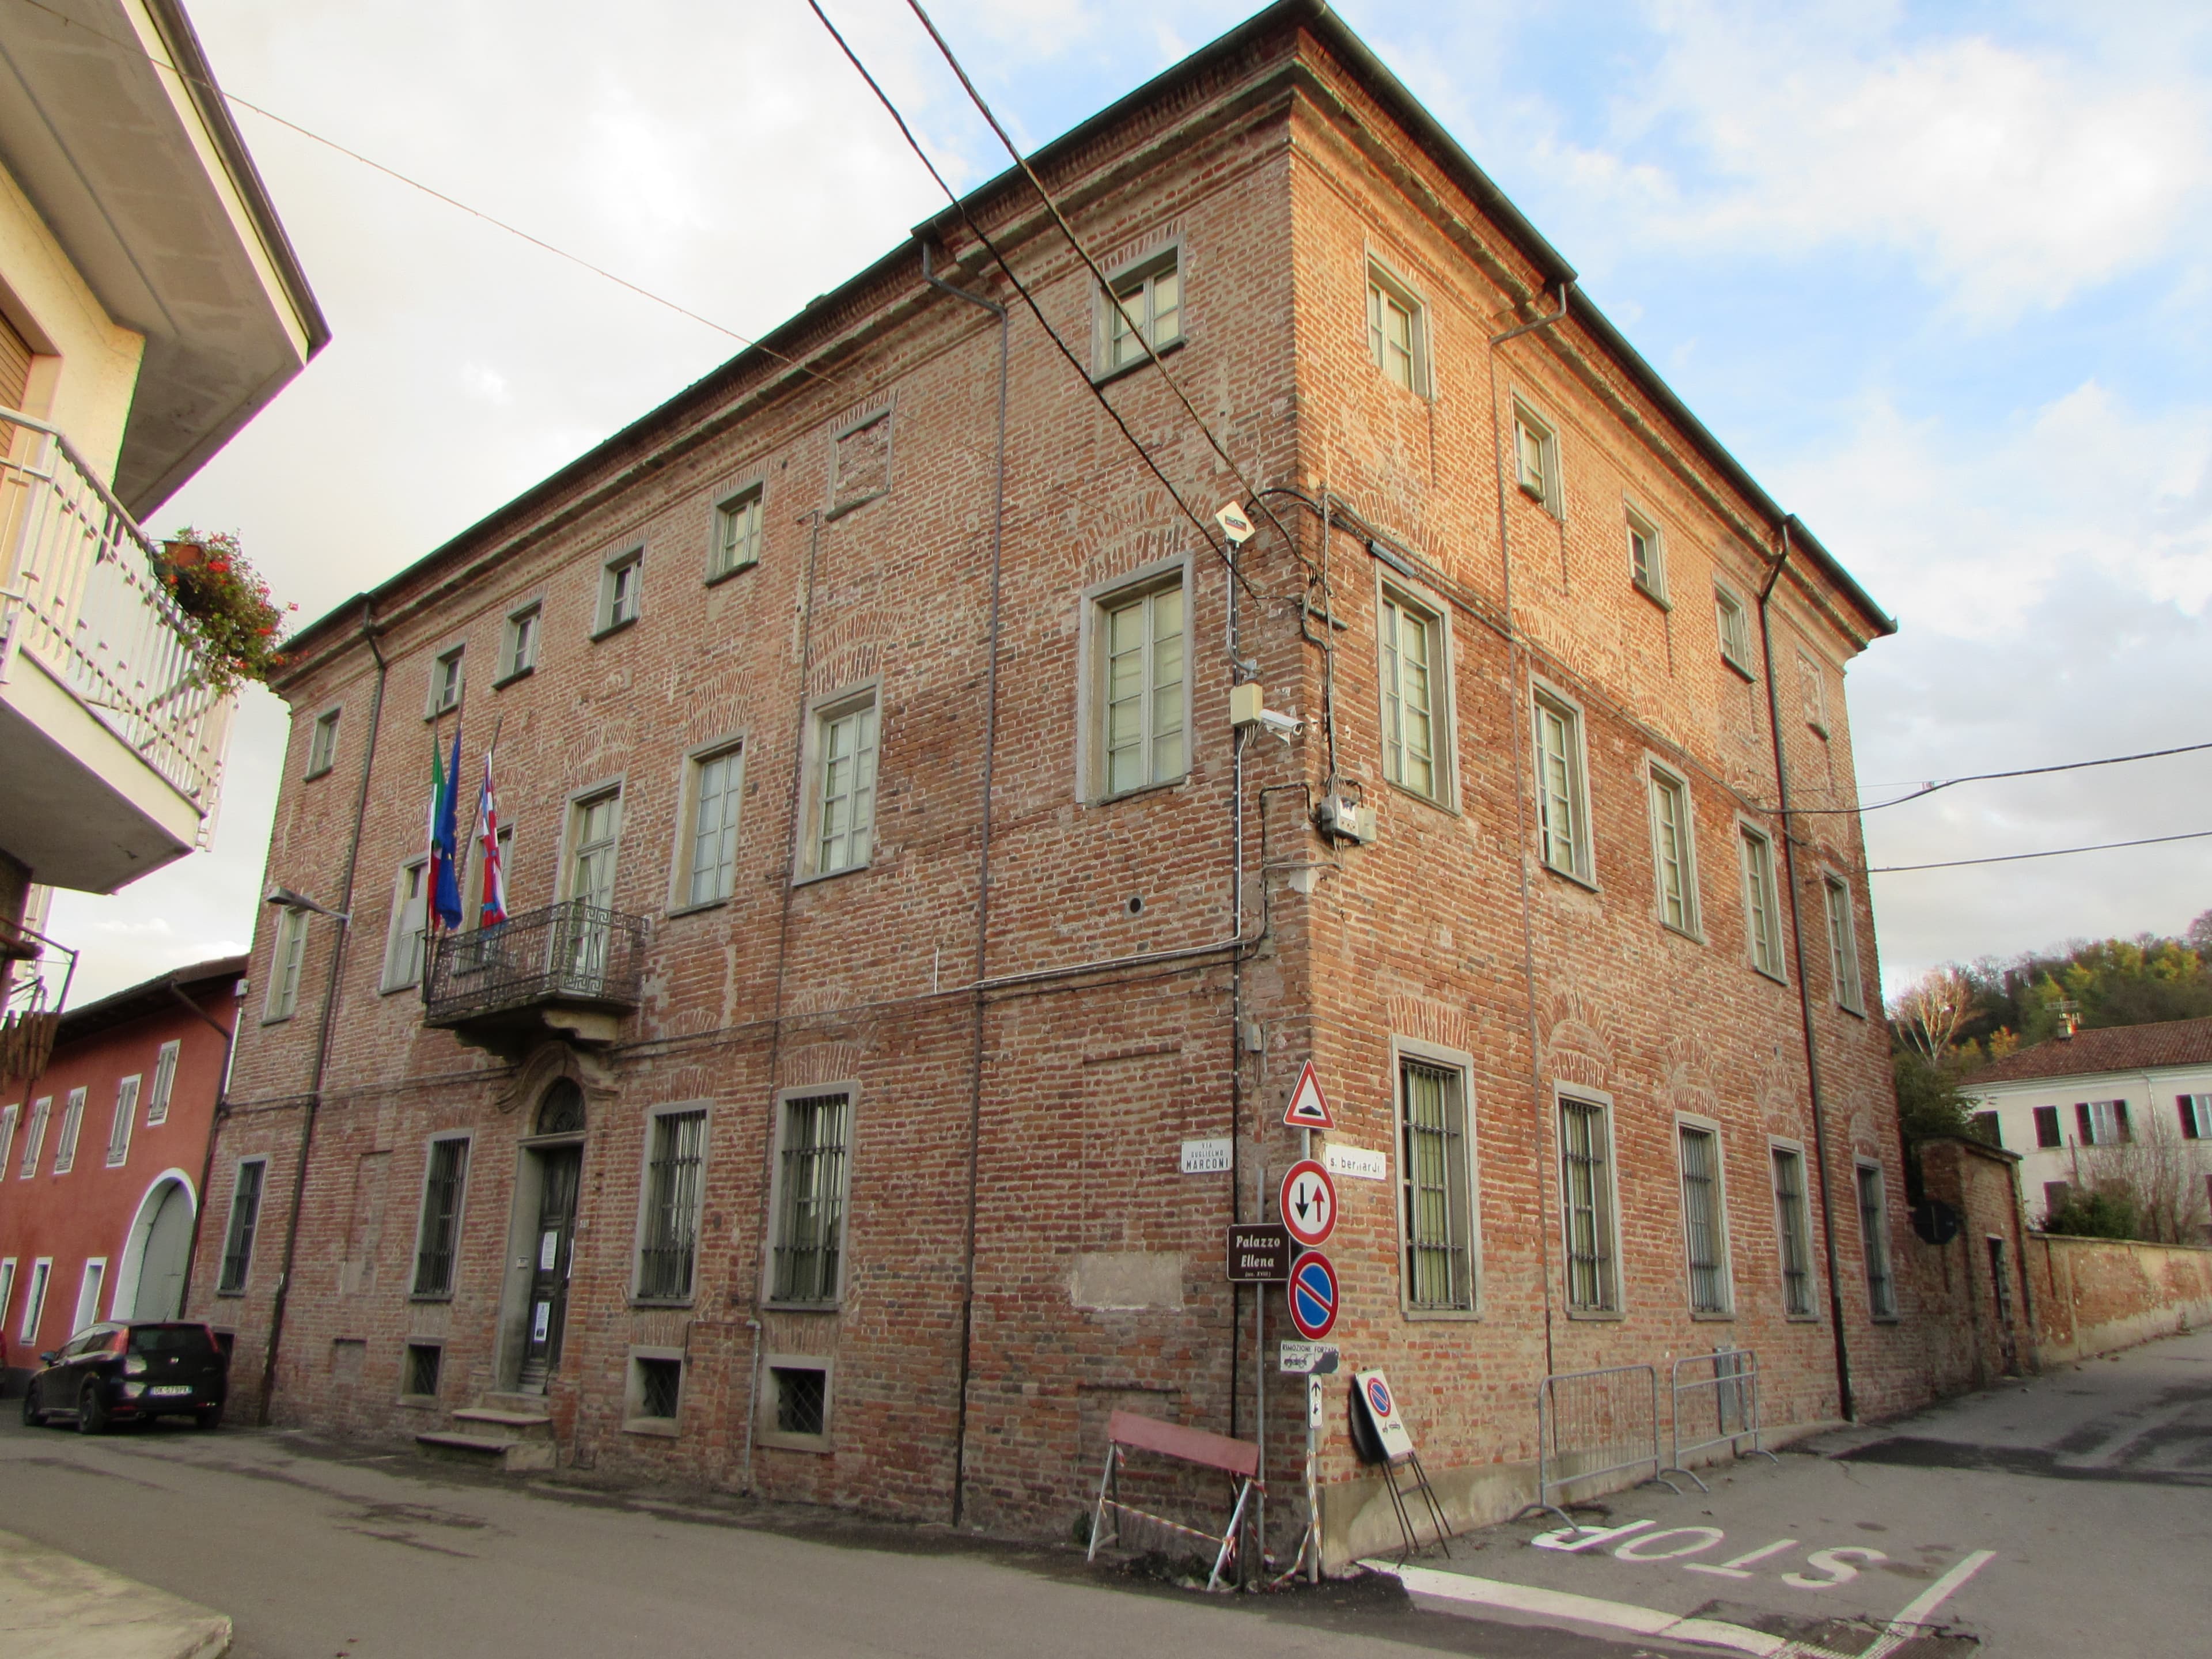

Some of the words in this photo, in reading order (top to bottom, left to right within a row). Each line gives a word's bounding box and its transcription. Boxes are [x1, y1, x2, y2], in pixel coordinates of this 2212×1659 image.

[1191, 1149, 1224, 1158] GUGLIELMO
[1187, 1157, 1228, 1171] MARCONI
[1236, 1234, 1281, 1248] Palazzo
[1241, 1254, 1274, 1268] Ellena
[1282, 1343, 1311, 1352] RIMOZIONE
[1531, 1519, 1888, 1589] STOP
